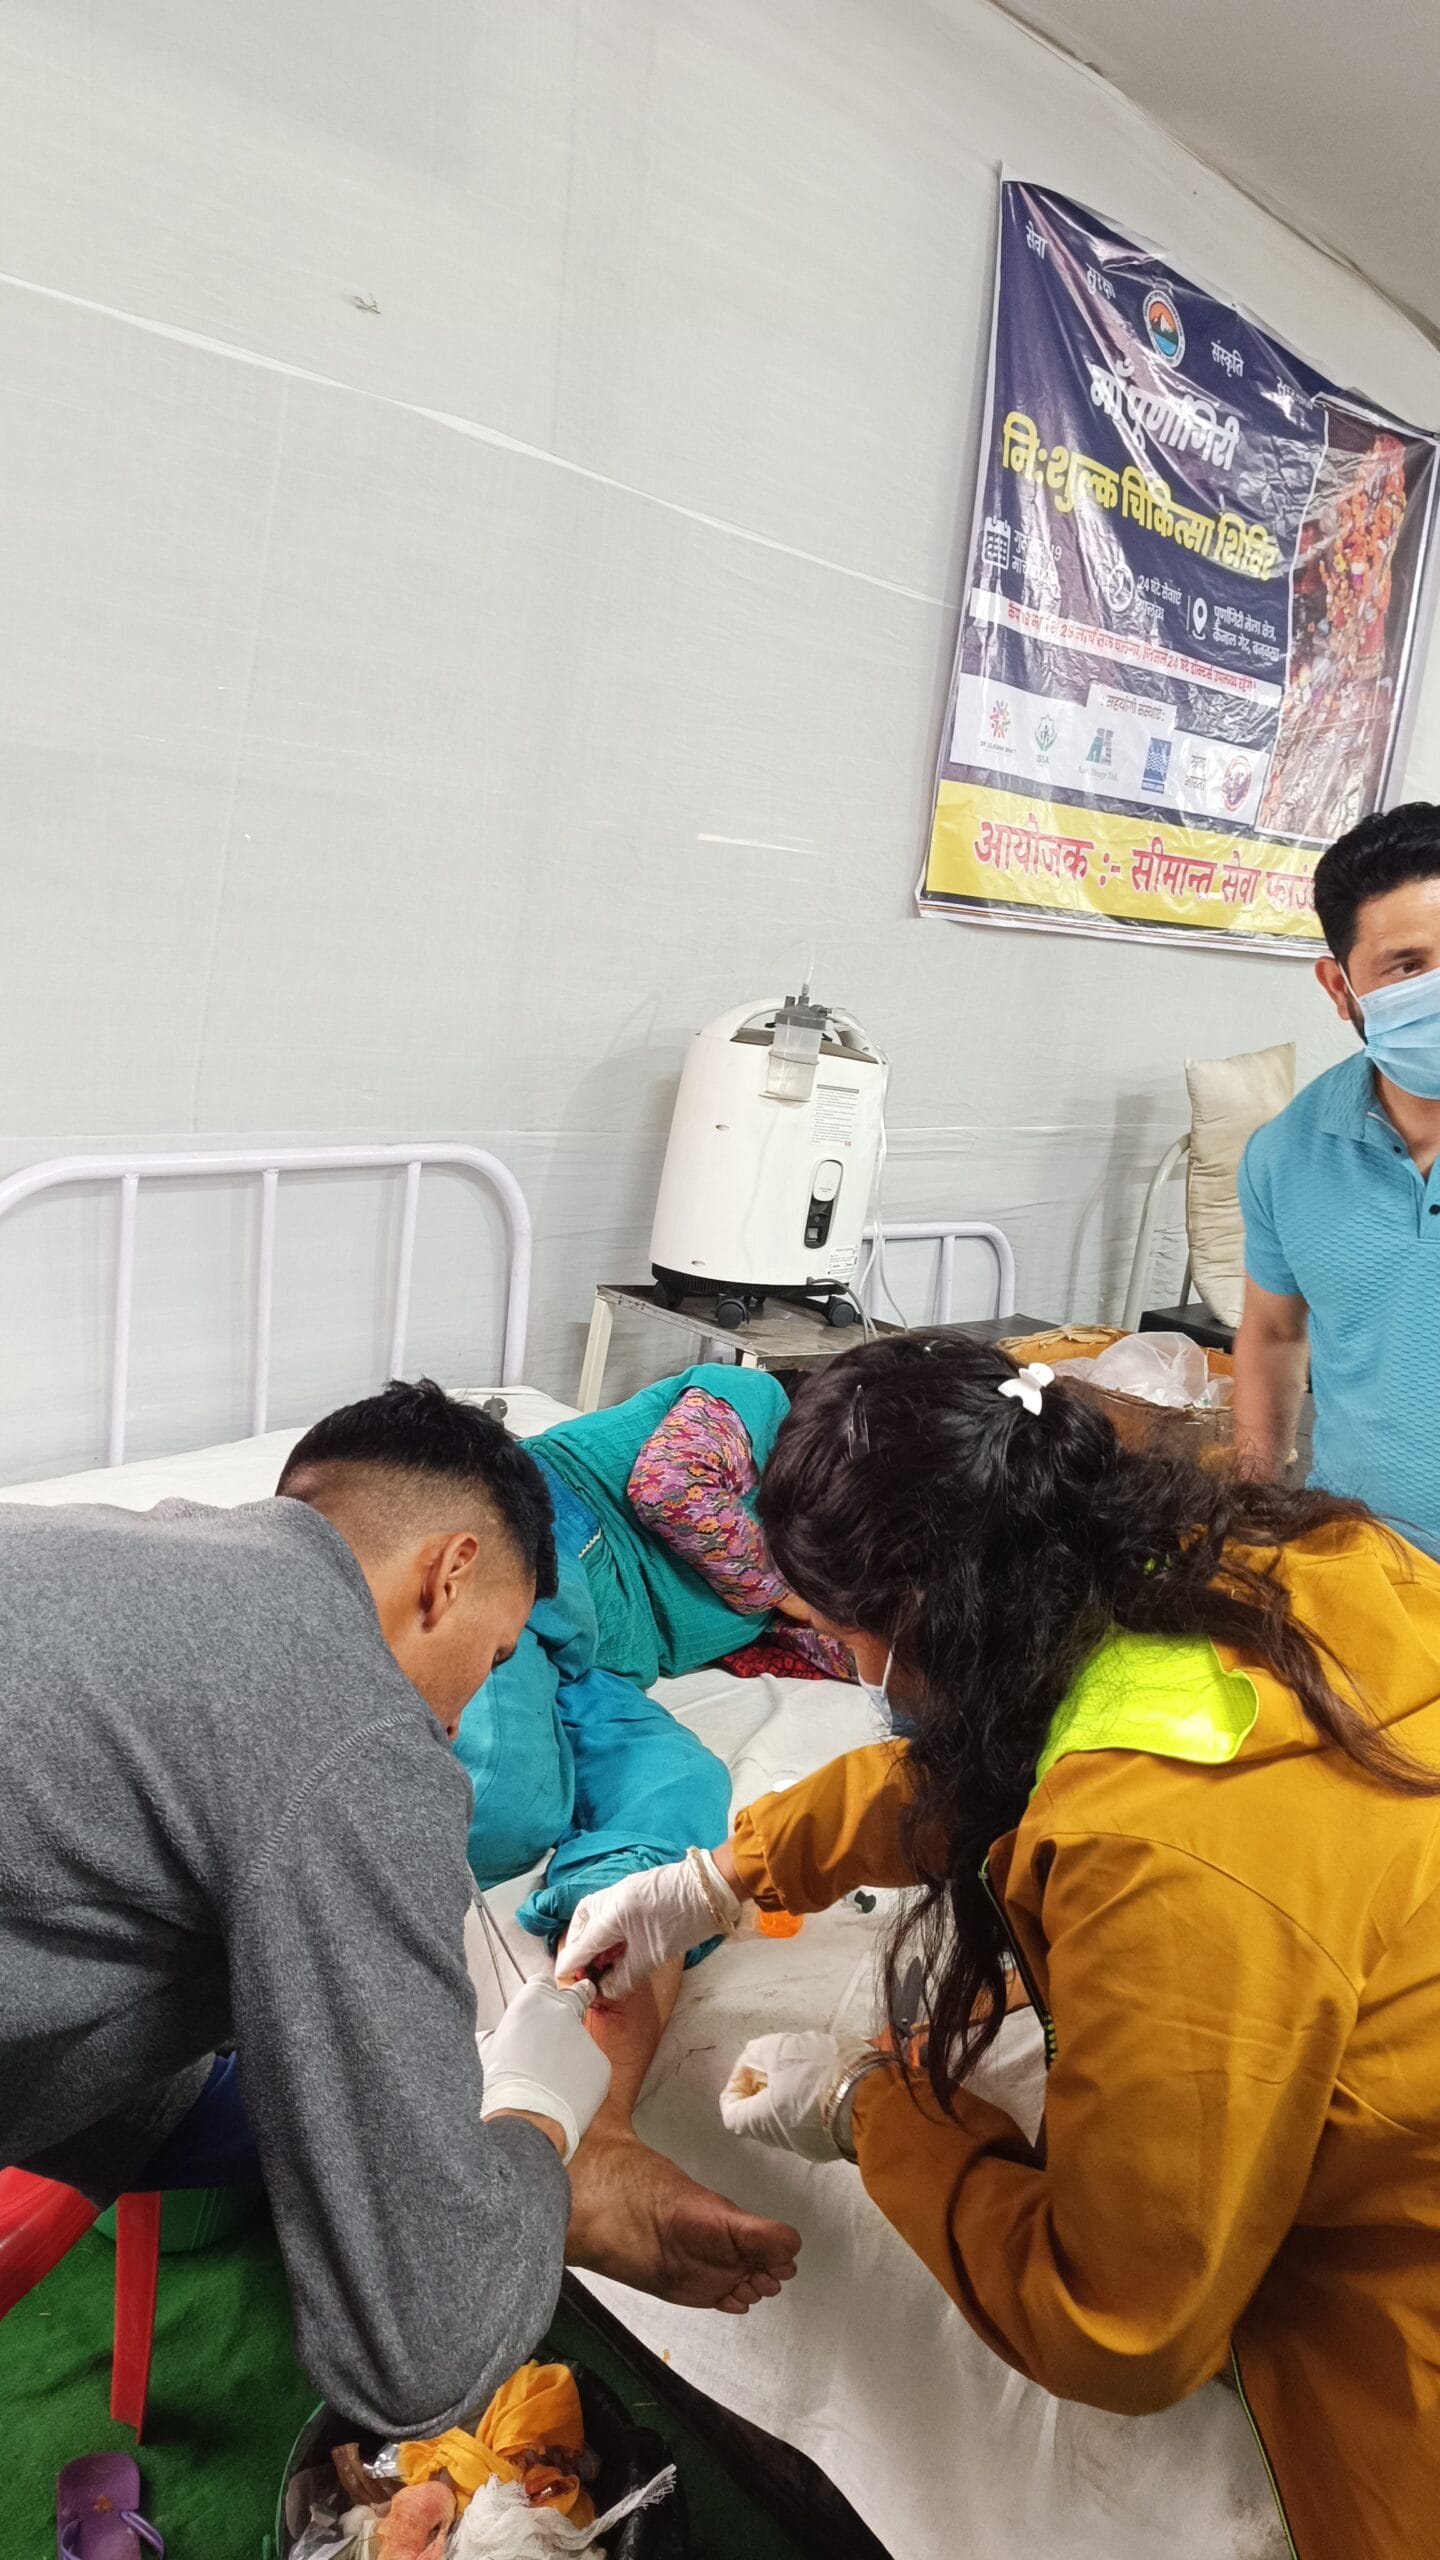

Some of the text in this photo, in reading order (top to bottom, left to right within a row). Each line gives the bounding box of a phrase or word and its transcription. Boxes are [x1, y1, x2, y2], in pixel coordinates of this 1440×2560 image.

[1025, 219, 1048, 259] सेवा
[1210, 338, 1245, 378] संस्कृति
[1120, 465, 1216, 556] चिकित्सा
[1214, 512, 1281, 581] शिविर
[1137, 574, 1150, 592] 24
[974, 812, 1095, 881] आयोजक
[1130, 836, 1218, 897] सीमान्त
[1220, 850, 1262, 905] सेवा
